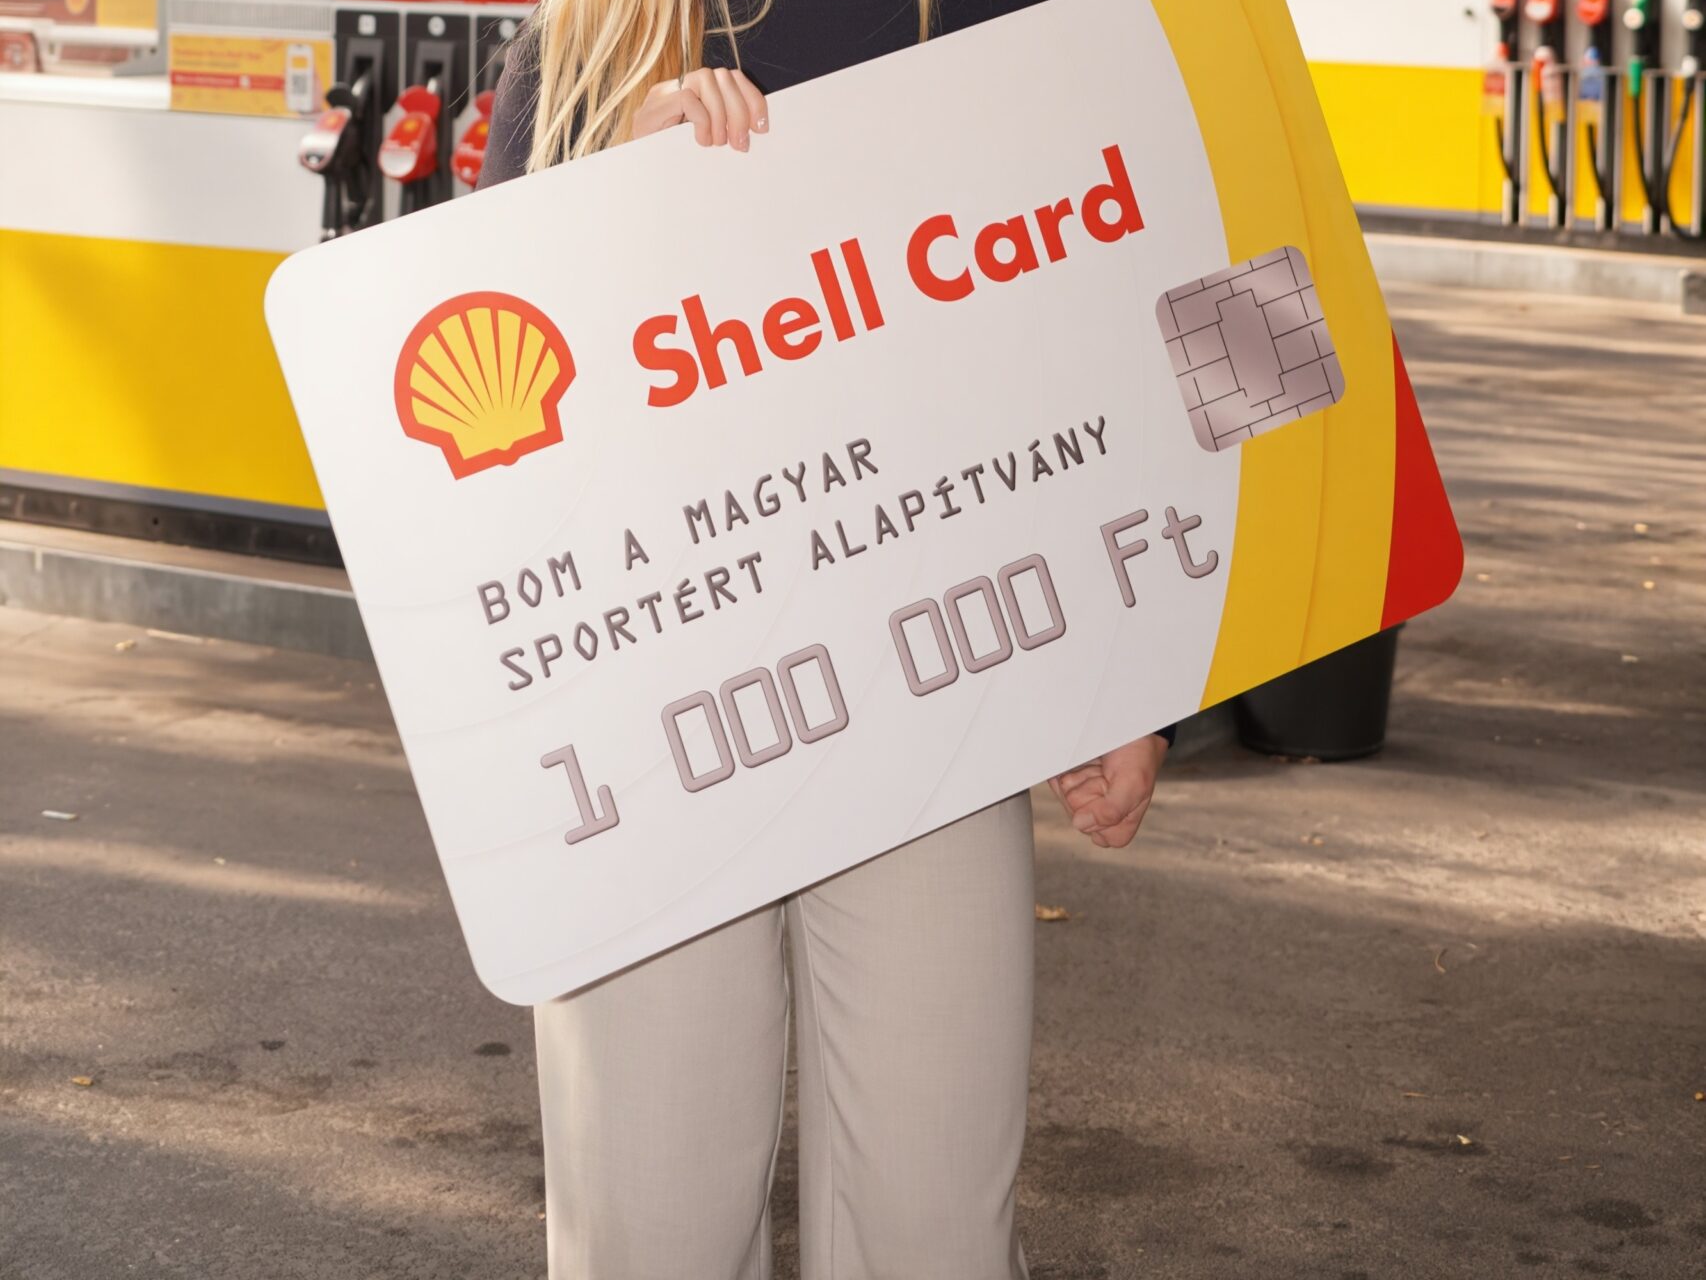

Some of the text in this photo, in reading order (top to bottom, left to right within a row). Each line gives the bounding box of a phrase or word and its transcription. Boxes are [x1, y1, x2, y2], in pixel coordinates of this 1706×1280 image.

[632, 144, 1145, 408] Shell Card
[476, 437, 880, 626] BOM A MAGYAR
[499, 415, 1108, 692] SPORTÉRT ALAPÍTVÁNY
[540, 505, 1220, 846] 1 000 000 Ft
